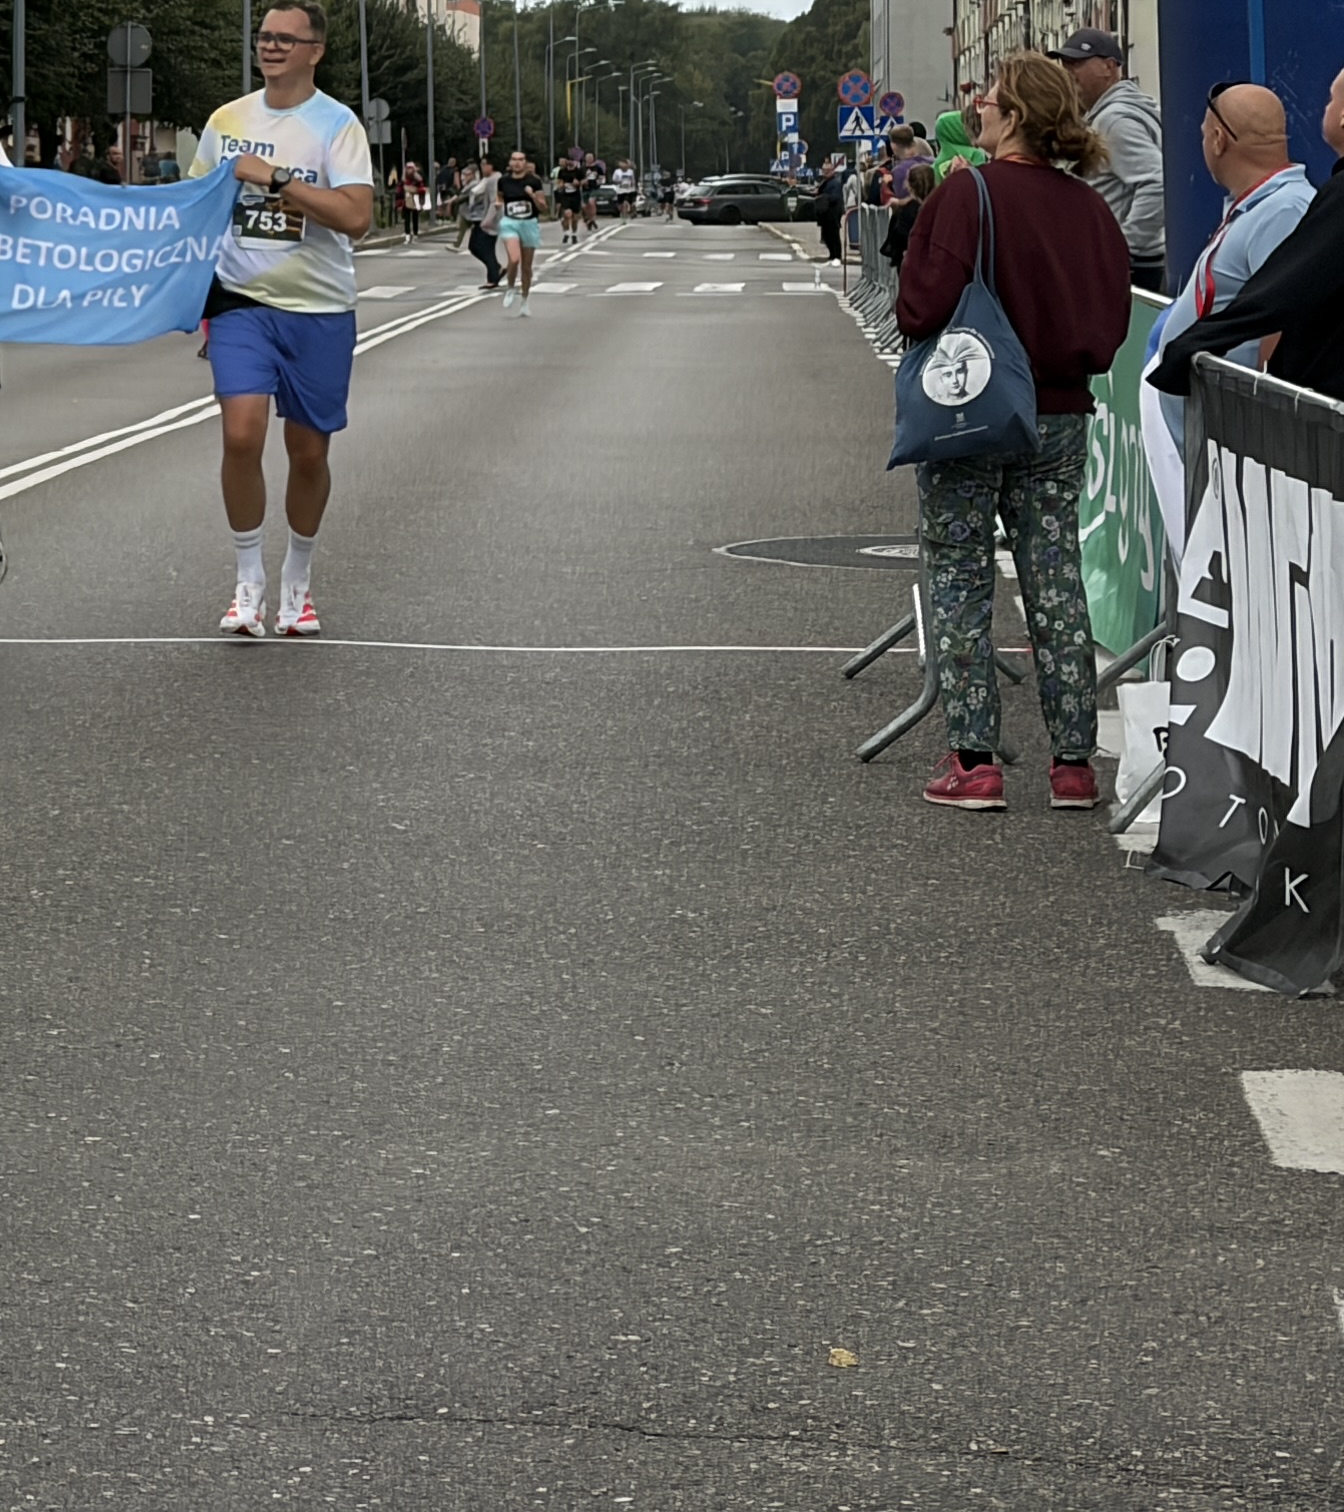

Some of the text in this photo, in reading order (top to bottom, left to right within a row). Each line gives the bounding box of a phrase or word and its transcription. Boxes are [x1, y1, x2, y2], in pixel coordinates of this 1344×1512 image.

[781, 114, 795, 131] P
[221, 135, 276, 158] Team
[10, 194, 181, 232] PORADNIA
[245, 209, 288, 233] 753
[12, 283, 73, 309] DLA
